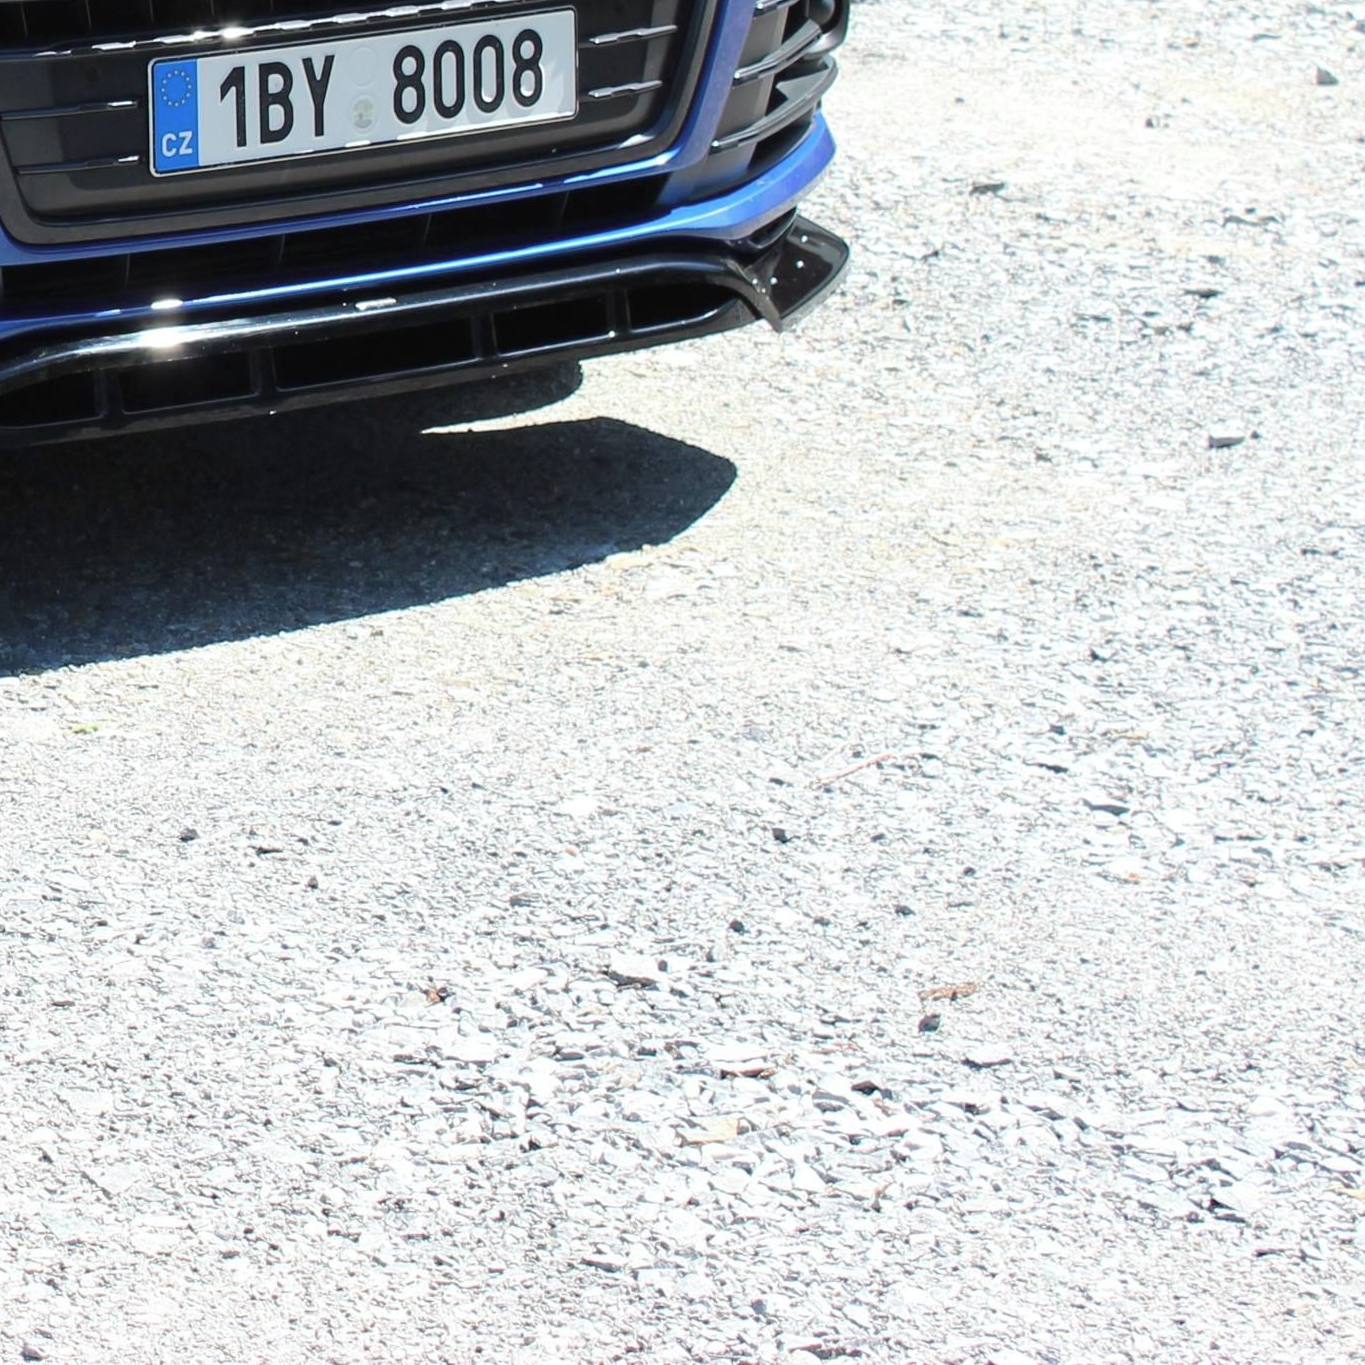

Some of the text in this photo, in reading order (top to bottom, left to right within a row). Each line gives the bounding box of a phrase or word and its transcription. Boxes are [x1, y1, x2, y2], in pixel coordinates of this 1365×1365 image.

[219, 28, 543, 148] 1BY 8008
[161, 131, 193, 158] CZ
